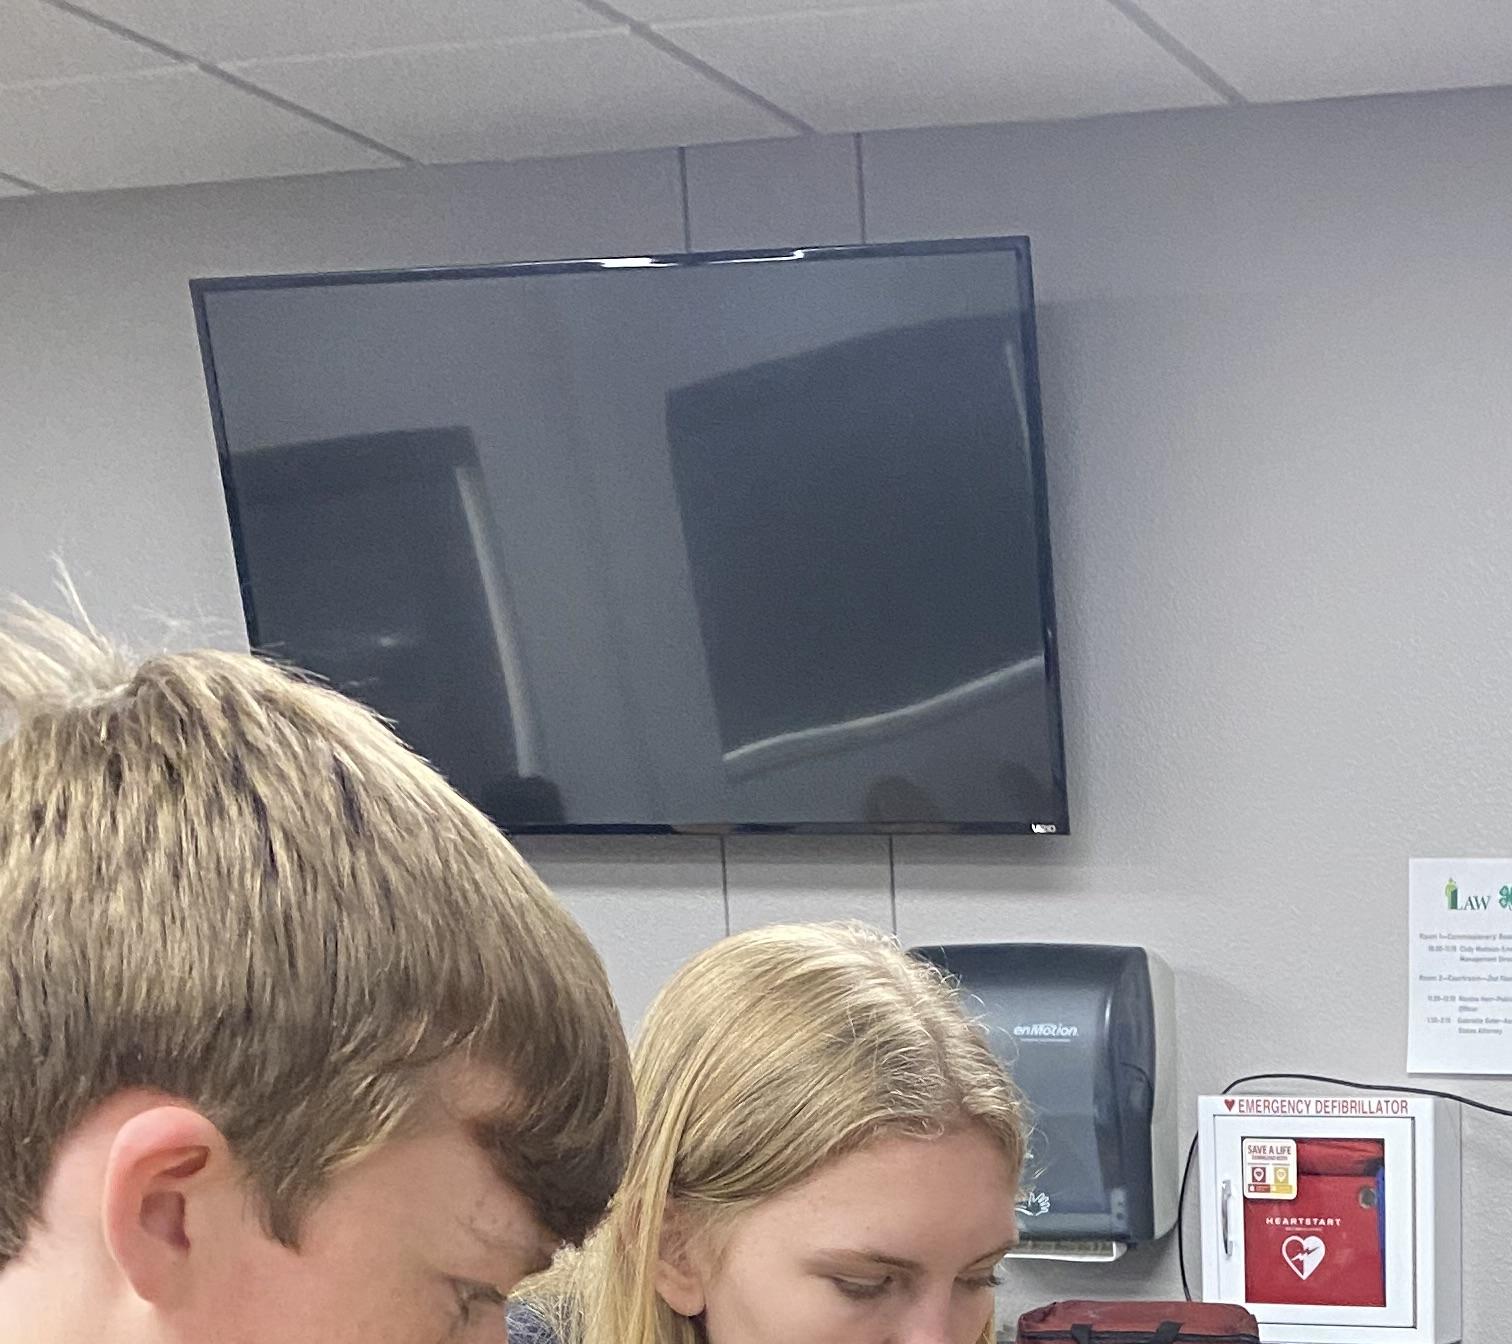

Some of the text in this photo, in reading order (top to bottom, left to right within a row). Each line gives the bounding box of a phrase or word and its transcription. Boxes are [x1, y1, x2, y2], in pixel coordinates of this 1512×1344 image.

[1238, 1099, 1409, 1114] EMERGENCY DEFIBRILLATOR
[1247, 1145, 1292, 1155] SAVE A LIFE
[1265, 1217, 1341, 1226] HEARTSTART
